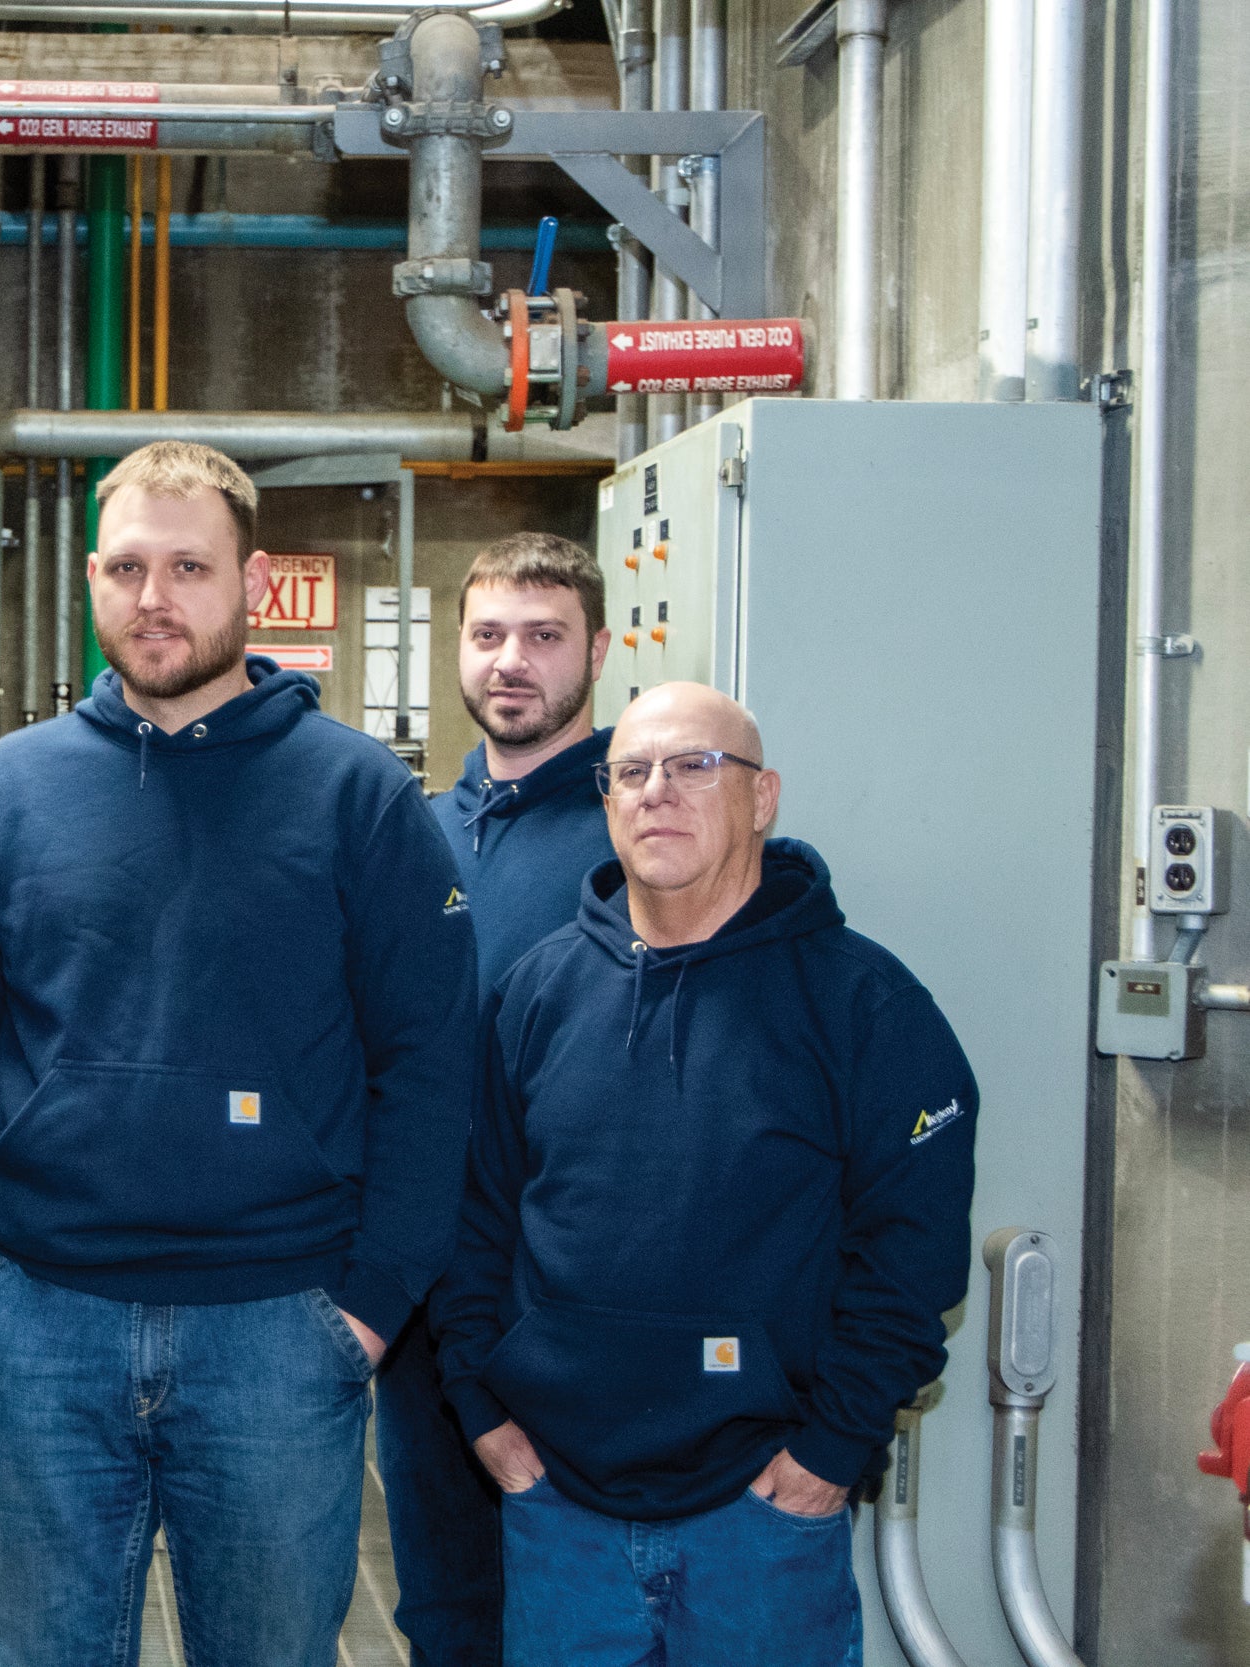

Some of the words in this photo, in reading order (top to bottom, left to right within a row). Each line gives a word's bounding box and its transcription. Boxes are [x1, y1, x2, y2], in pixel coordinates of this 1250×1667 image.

[19, 119, 40, 136] CO2
[68, 120, 103, 137] PURGE
[105, 120, 153, 139] EXHAUST
[638, 331, 693, 352] EXHAUST
[695, 329, 736, 349] PURGE
[768, 326, 792, 346] CO2
[637, 379, 662, 393] CO2
[694, 376, 735, 391] PURGE
[737, 374, 792, 390] EXHAUST
[270, 557, 329, 573] RGENCY
[264, 576, 323, 619] XIT
